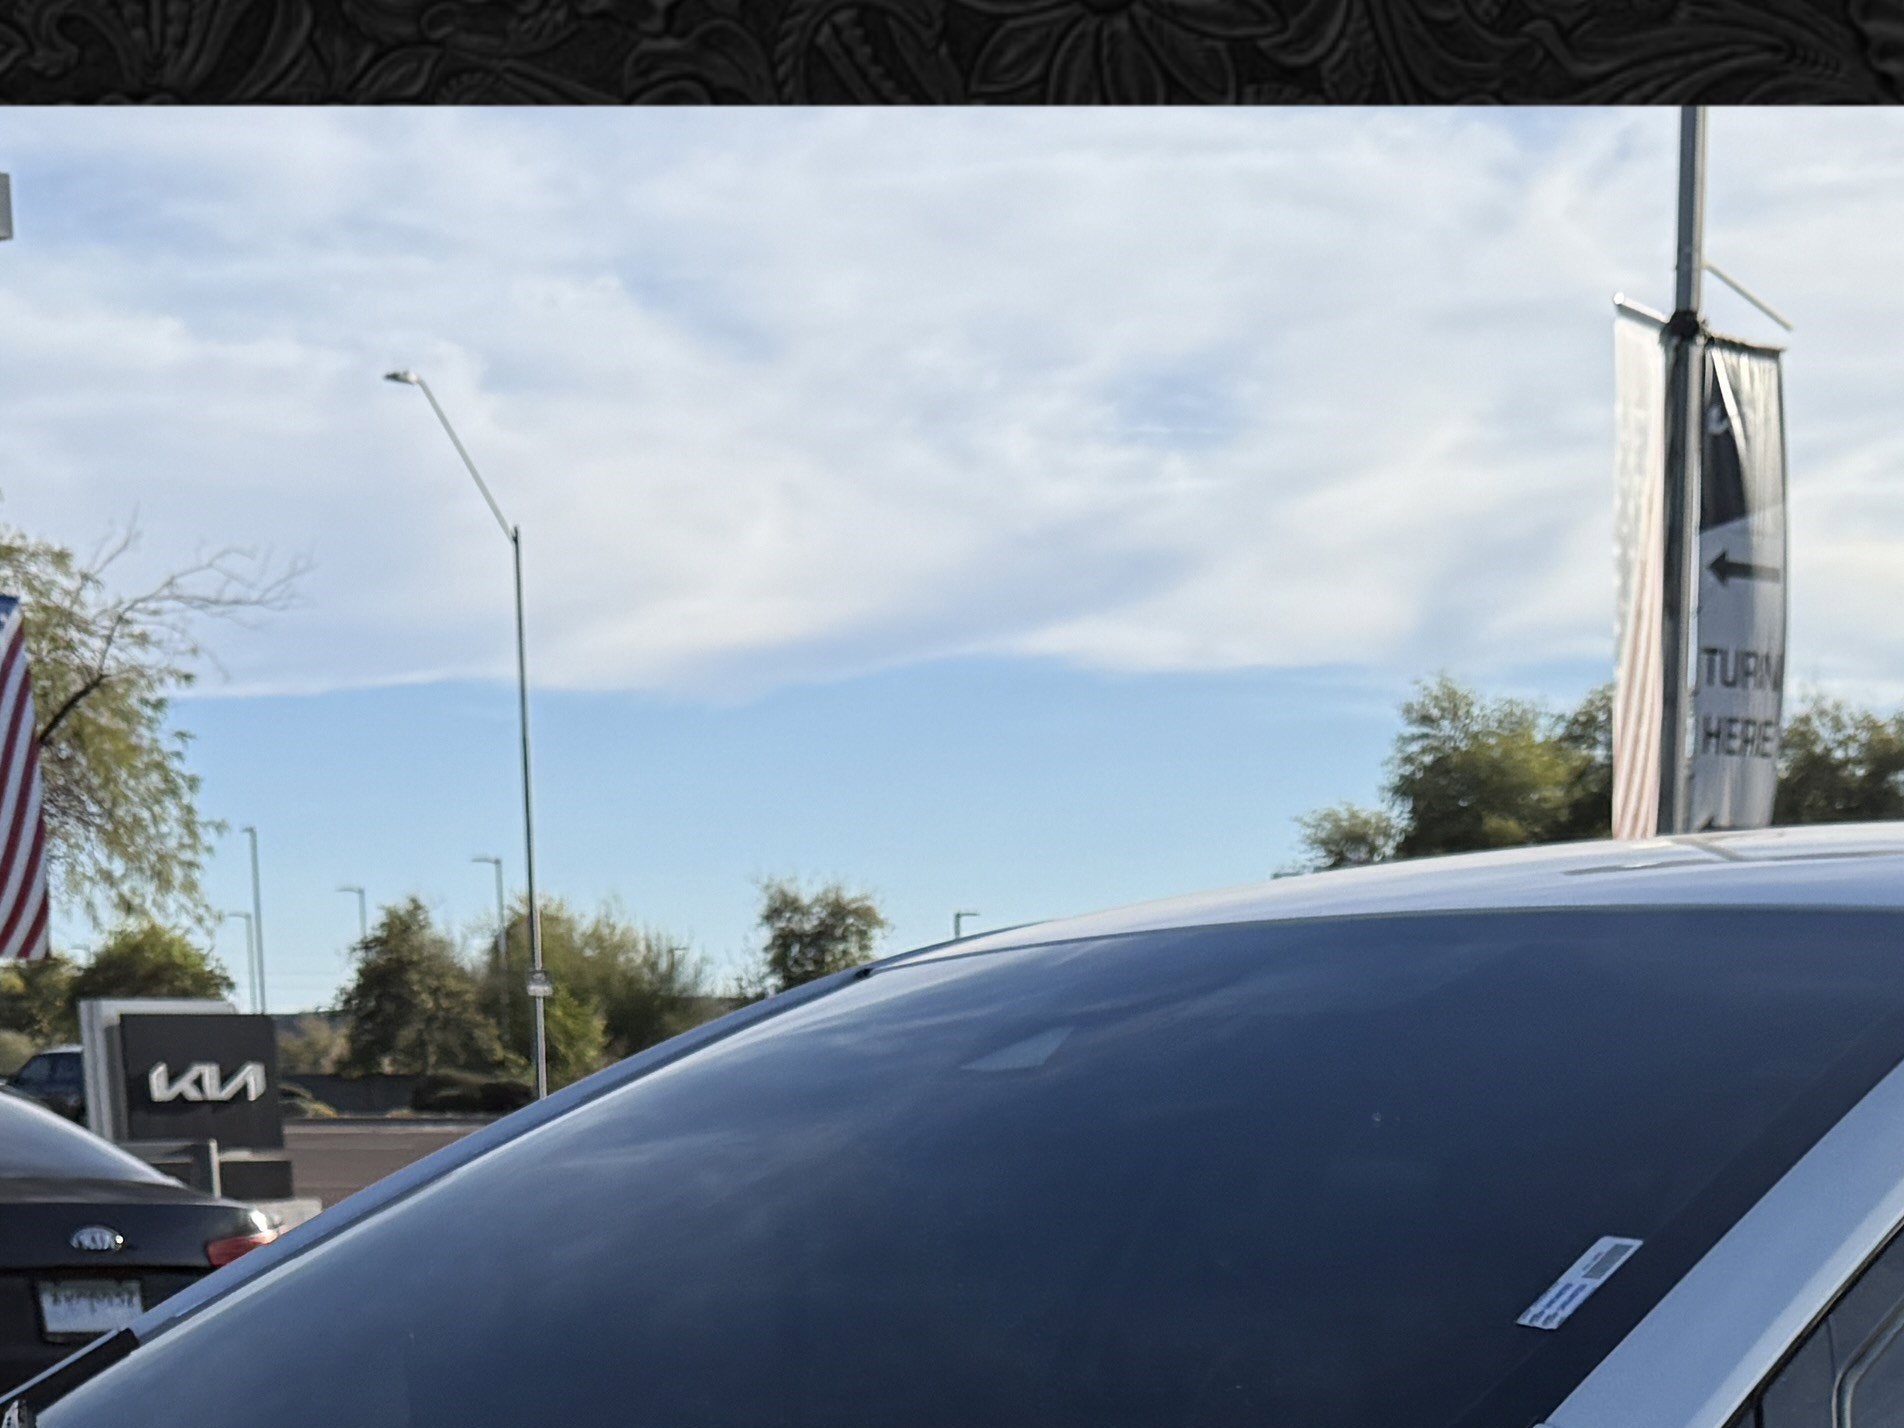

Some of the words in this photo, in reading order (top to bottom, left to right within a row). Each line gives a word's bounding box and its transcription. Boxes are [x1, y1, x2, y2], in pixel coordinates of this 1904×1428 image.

[1700, 647, 1784, 690] TURN
[1701, 716, 1774, 758] HERE
[149, 1061, 266, 1101] KIA
